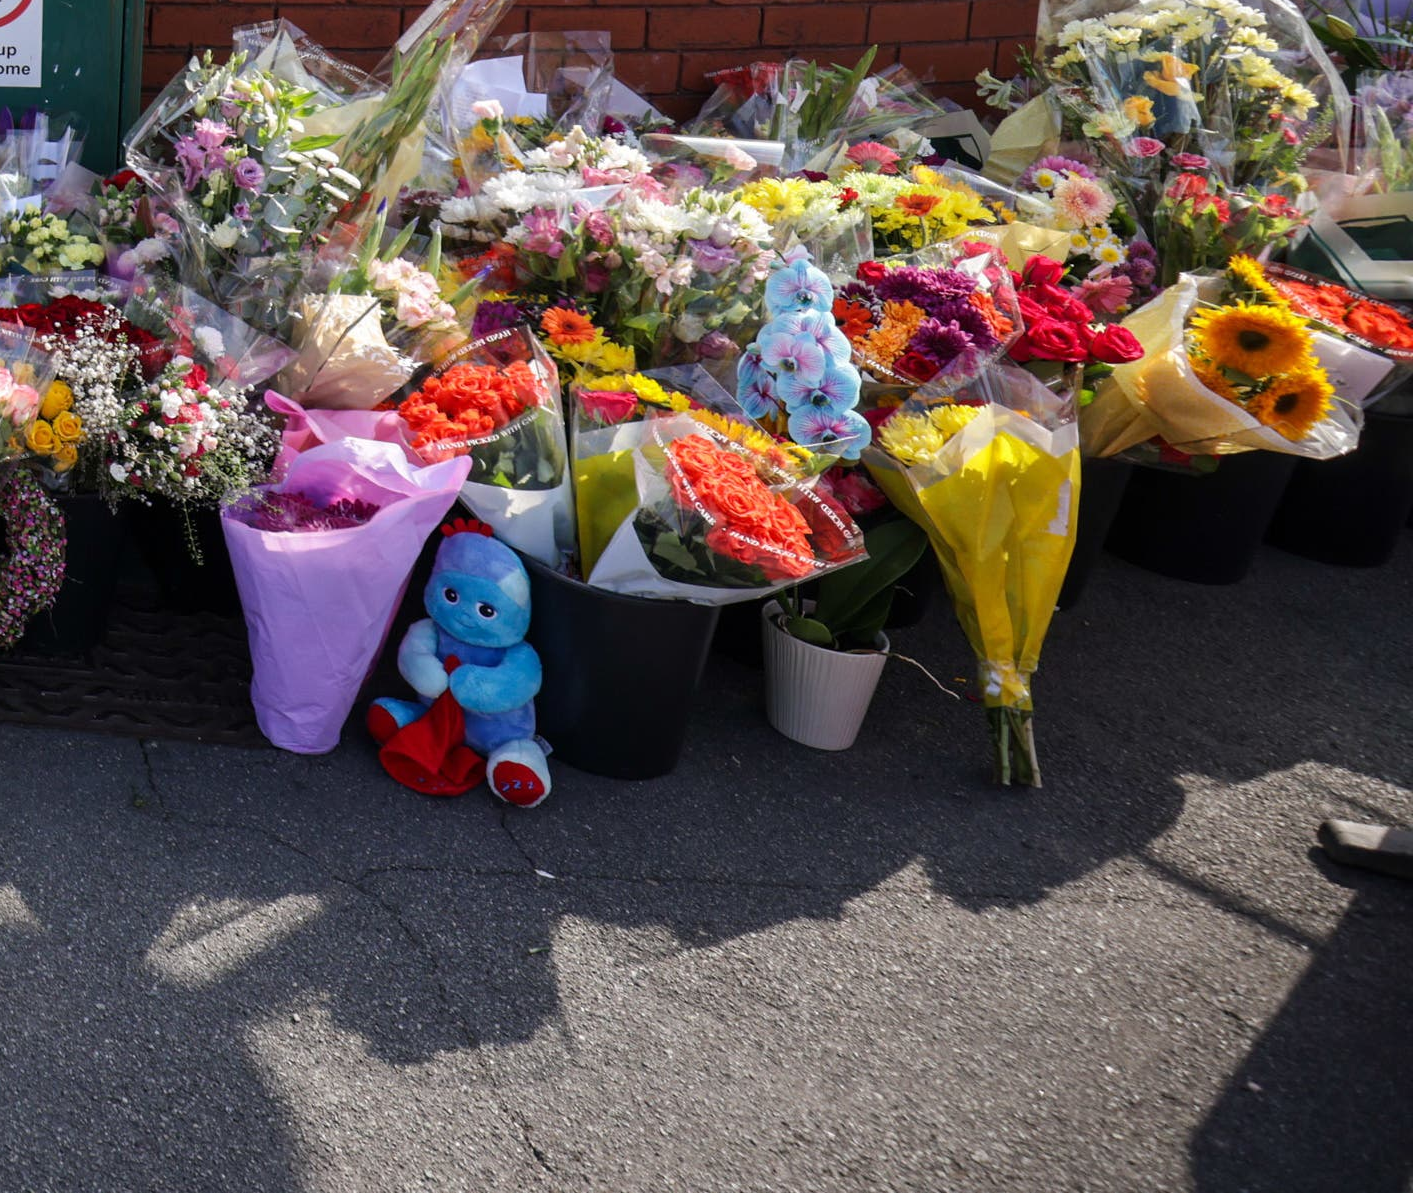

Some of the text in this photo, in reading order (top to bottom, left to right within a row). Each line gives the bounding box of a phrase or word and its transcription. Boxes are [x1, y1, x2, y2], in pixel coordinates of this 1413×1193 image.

[866, 359, 895, 377] HAND
[437, 441, 465, 451] HAND
[467, 434, 500, 447] PICKED
[694, 501, 717, 526] CARE
[729, 530, 760, 547] HAND
[761, 544, 797, 559] PICKED
